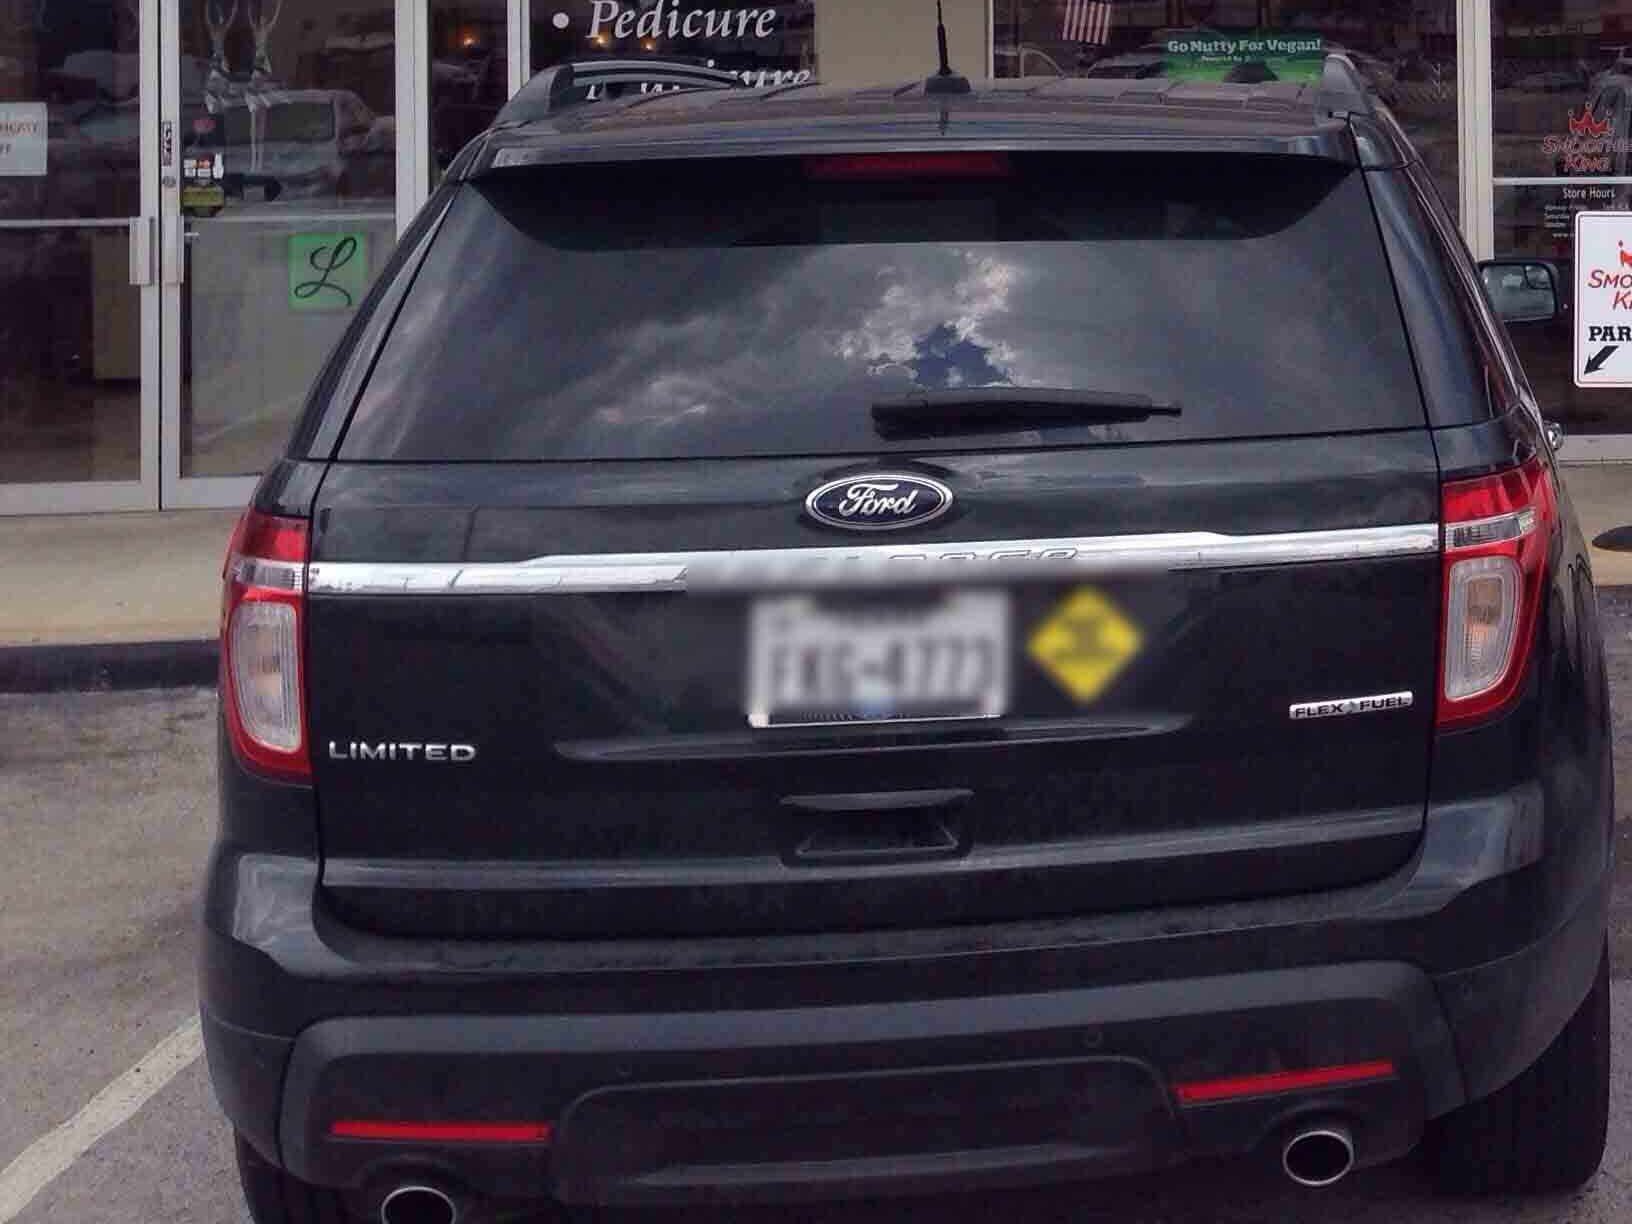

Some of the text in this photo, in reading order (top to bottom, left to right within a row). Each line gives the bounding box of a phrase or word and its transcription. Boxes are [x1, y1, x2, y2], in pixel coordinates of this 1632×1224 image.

[1167, 39, 1321, 54] Go Nutty For Vegan!
[1562, 187, 1616, 200] Store Hours
[838, 482, 918, 517] Ford
[1295, 695, 1411, 718] FLEX FUEL
[328, 740, 476, 762] LIMITED
